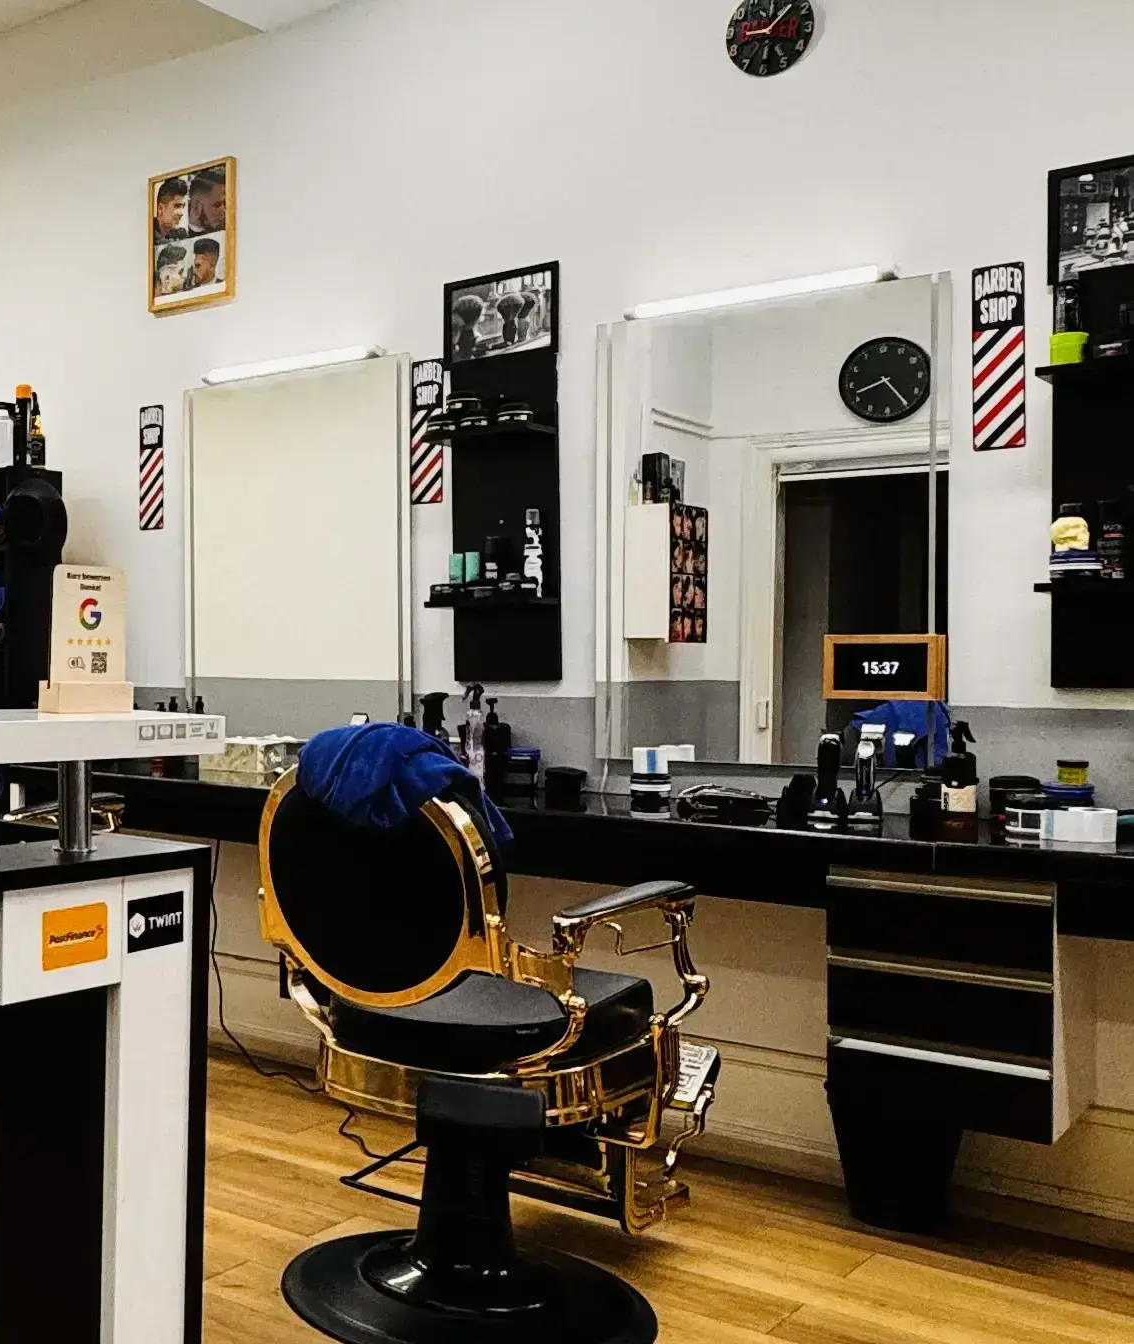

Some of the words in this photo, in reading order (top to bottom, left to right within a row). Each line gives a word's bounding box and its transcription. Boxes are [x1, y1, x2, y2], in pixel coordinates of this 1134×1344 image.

[800, 2, 810, 15] 2
[804, 21, 813, 32] 3
[730, 44, 738, 56] 8
[795, 39, 805, 51] 4
[742, 59, 750, 70] 7
[779, 57, 788, 68] 5
[759, 64, 767, 75] 6
[974, 267, 1023, 301] BARBER
[980, 296, 1017, 324] SHOP
[413, 361, 443, 388] BARBER
[416, 384, 439, 406] SHOP
[862, 661, 900, 675] 15:37
[148, 911, 183, 929] TWINT
[48, 928, 96, 945] PostFinance
